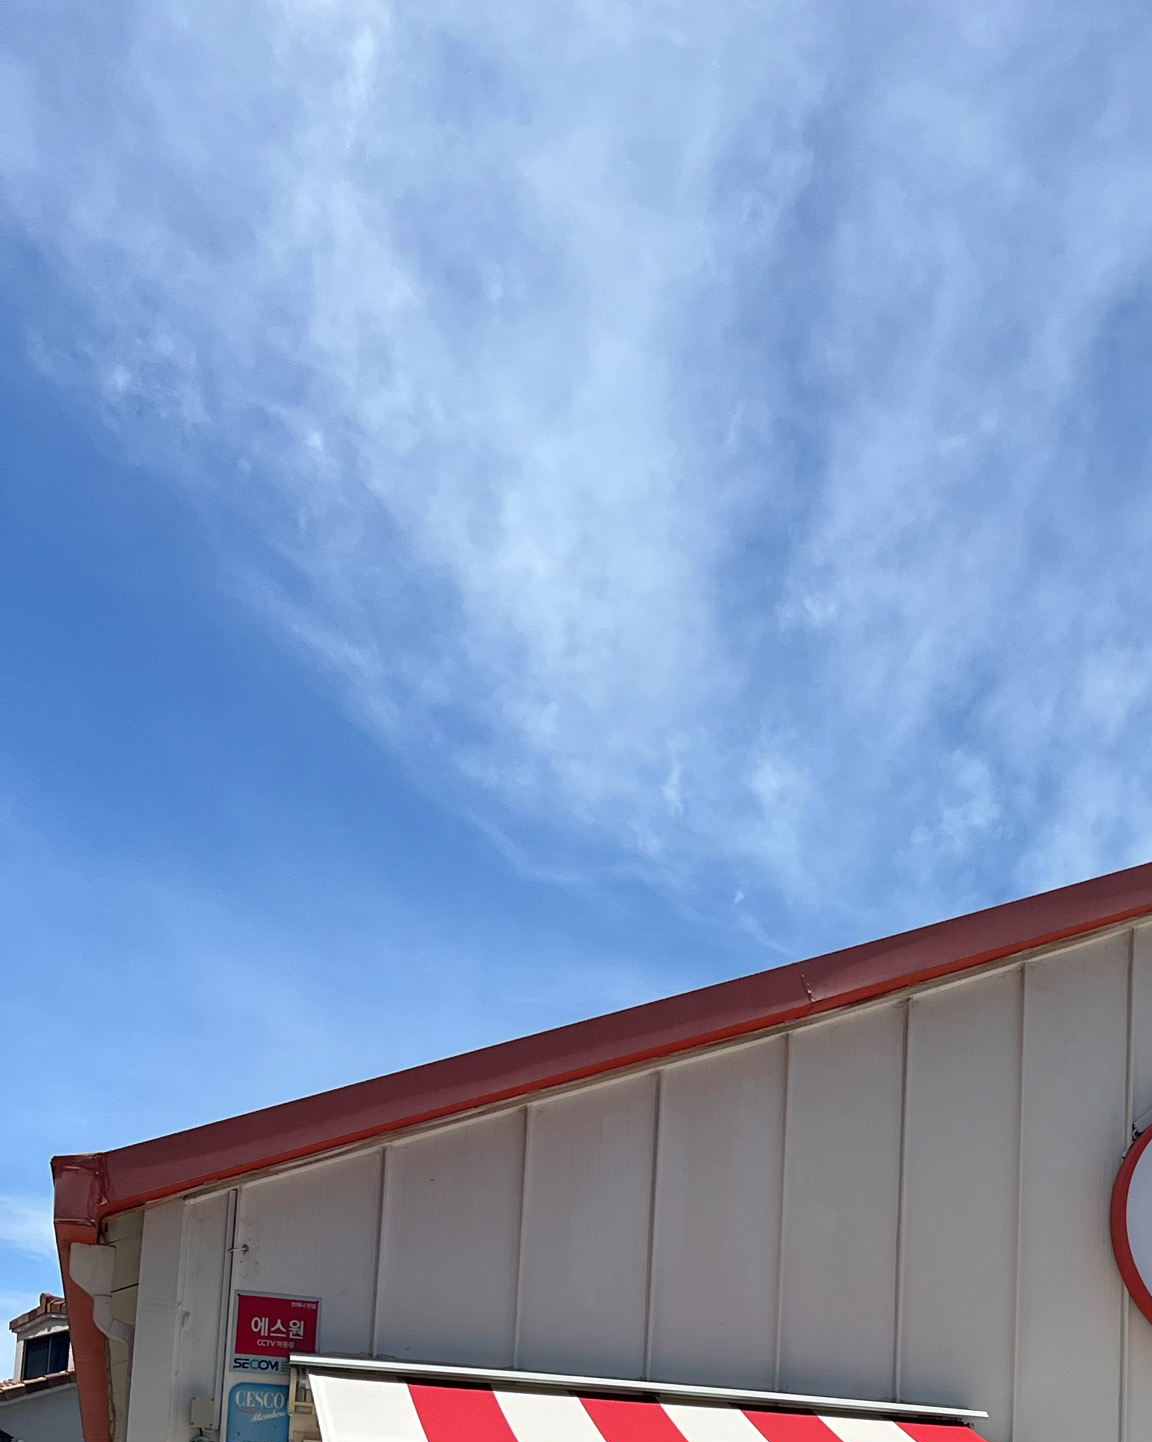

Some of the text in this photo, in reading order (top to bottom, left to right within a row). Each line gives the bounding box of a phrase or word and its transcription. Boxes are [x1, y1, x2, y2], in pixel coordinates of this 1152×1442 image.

[251, 1316, 304, 1339] 에스원
[257, 1339, 275, 1347] CCTV
[233, 1358, 279, 1371] SECOM
[235, 1390, 285, 1409] CESCO
